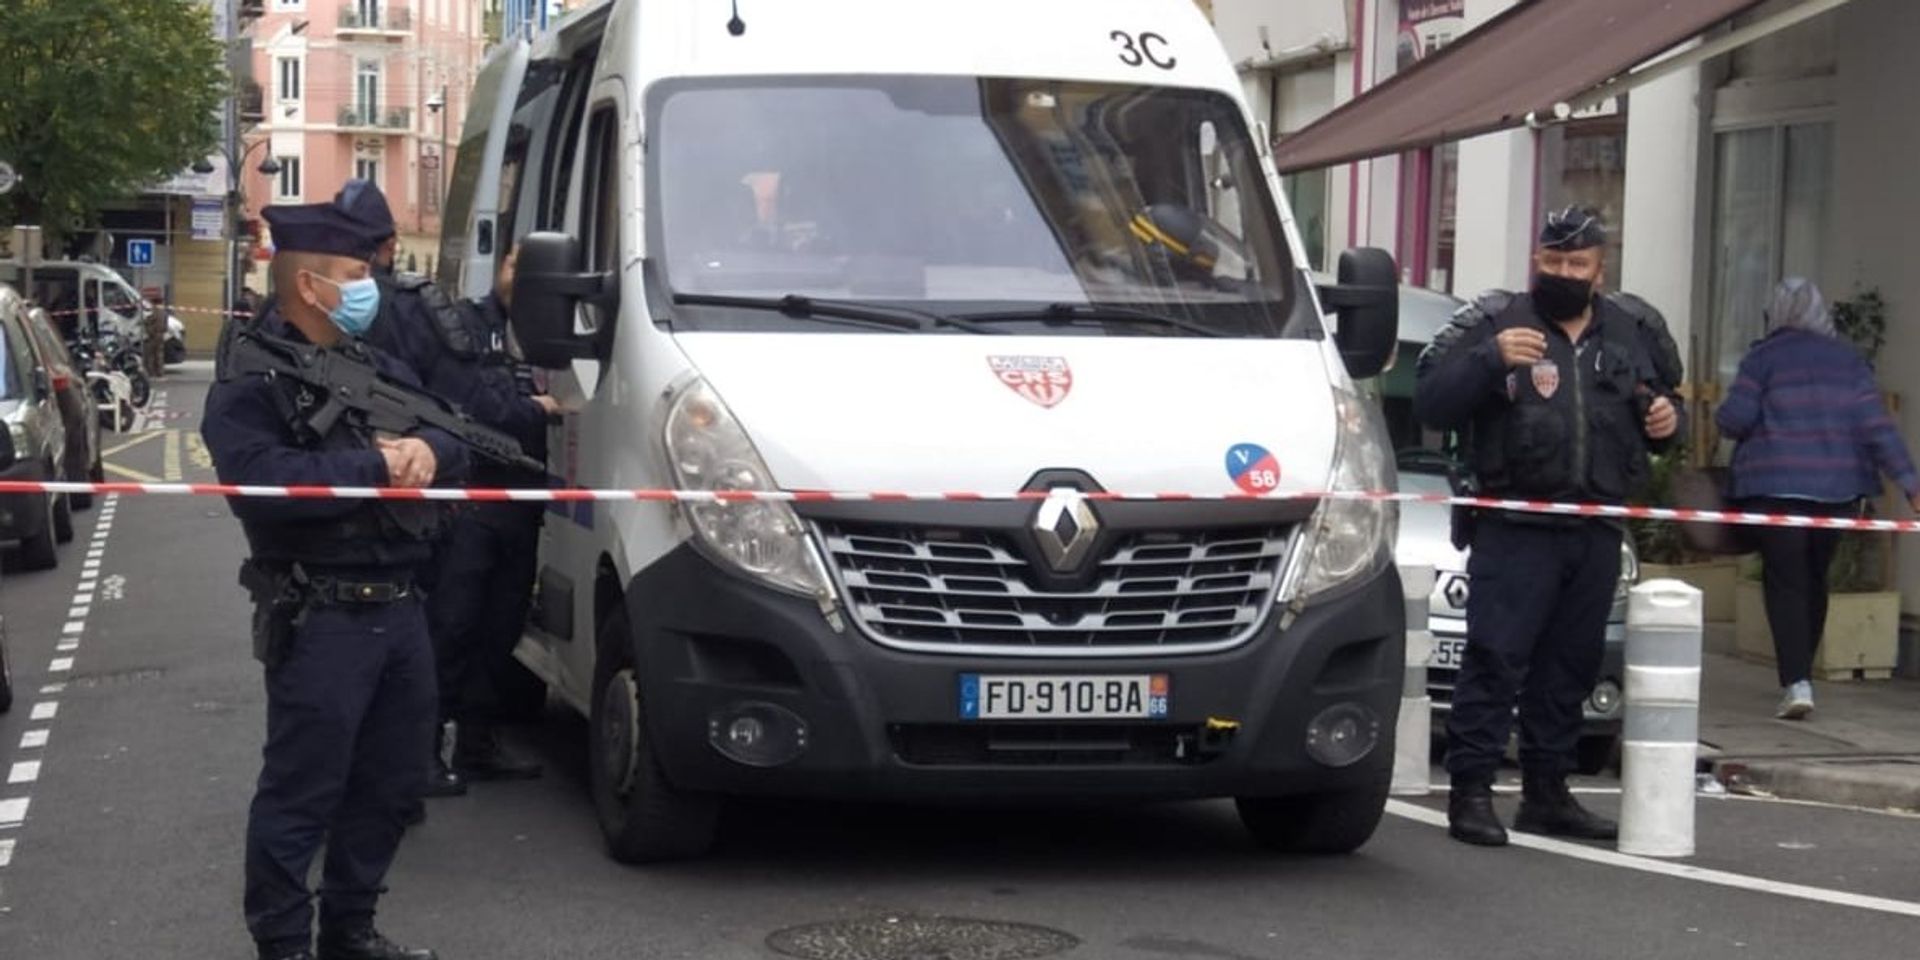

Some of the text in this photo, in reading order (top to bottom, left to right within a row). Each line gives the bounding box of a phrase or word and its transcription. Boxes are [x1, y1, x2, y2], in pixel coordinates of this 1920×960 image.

[1110, 30, 1176, 70] 3C
[1001, 370, 1069, 385] CRS
[1234, 450, 1249, 465] V
[1250, 470, 1276, 488] 58
[986, 681, 1142, 713] FD-910-BA
[1150, 698, 1167, 714] 66
